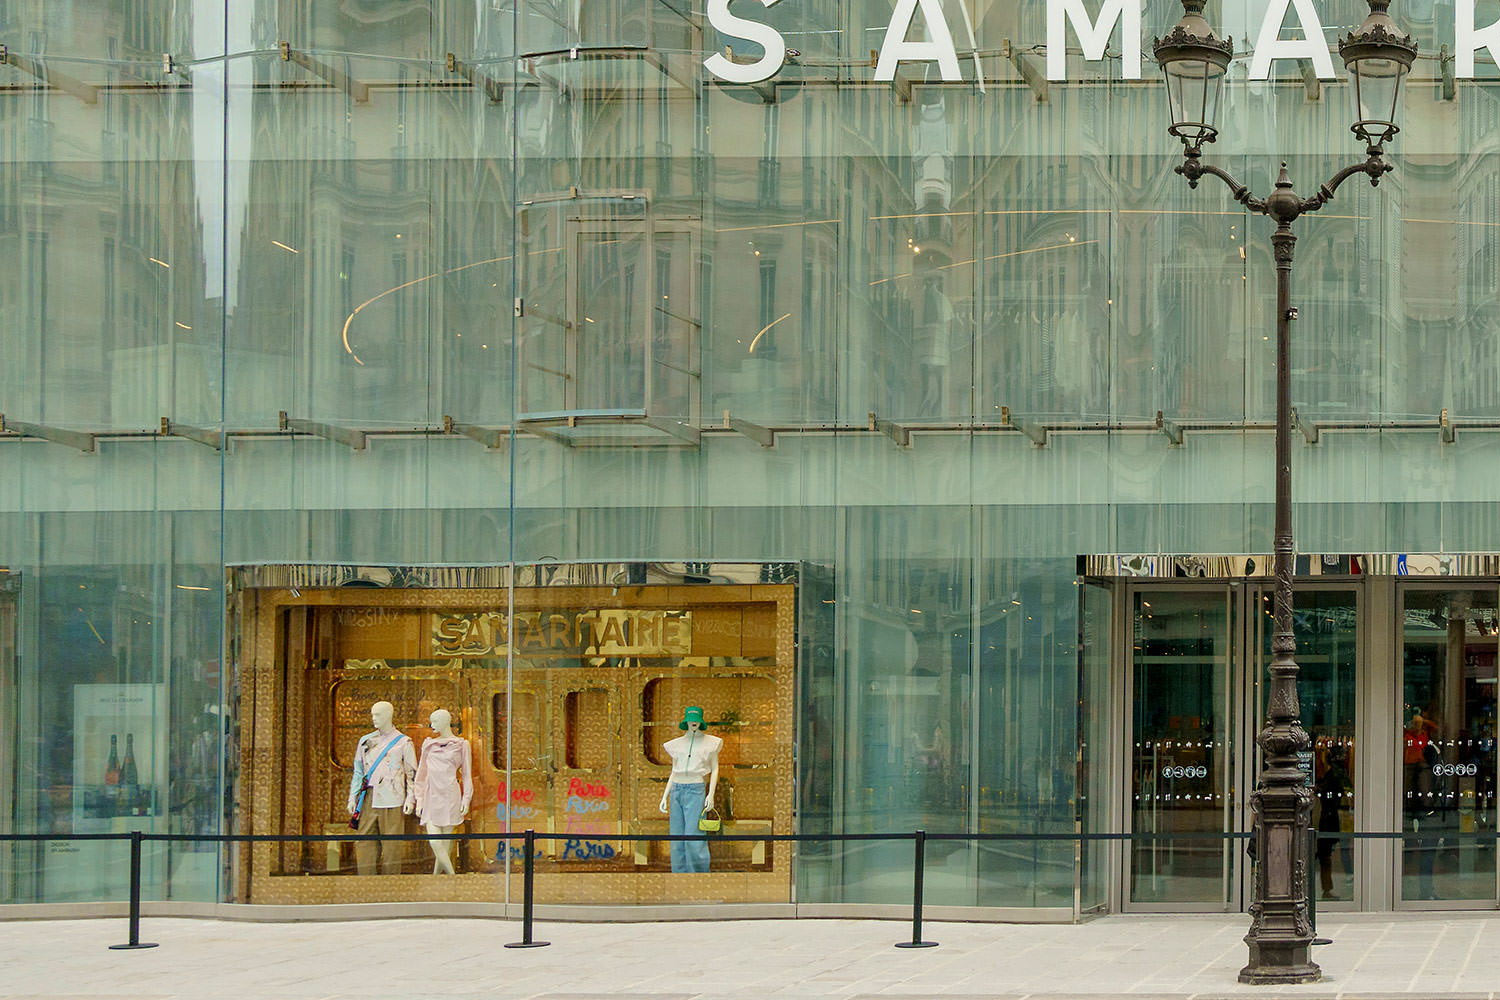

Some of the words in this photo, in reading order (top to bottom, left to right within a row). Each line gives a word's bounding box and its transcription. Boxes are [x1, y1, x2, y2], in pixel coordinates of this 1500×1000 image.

[440, 615, 681, 649] SAMARITAINE
[567, 777, 610, 798] Paris
[566, 795, 609, 814] Paris
[562, 838, 616, 860] Paris
